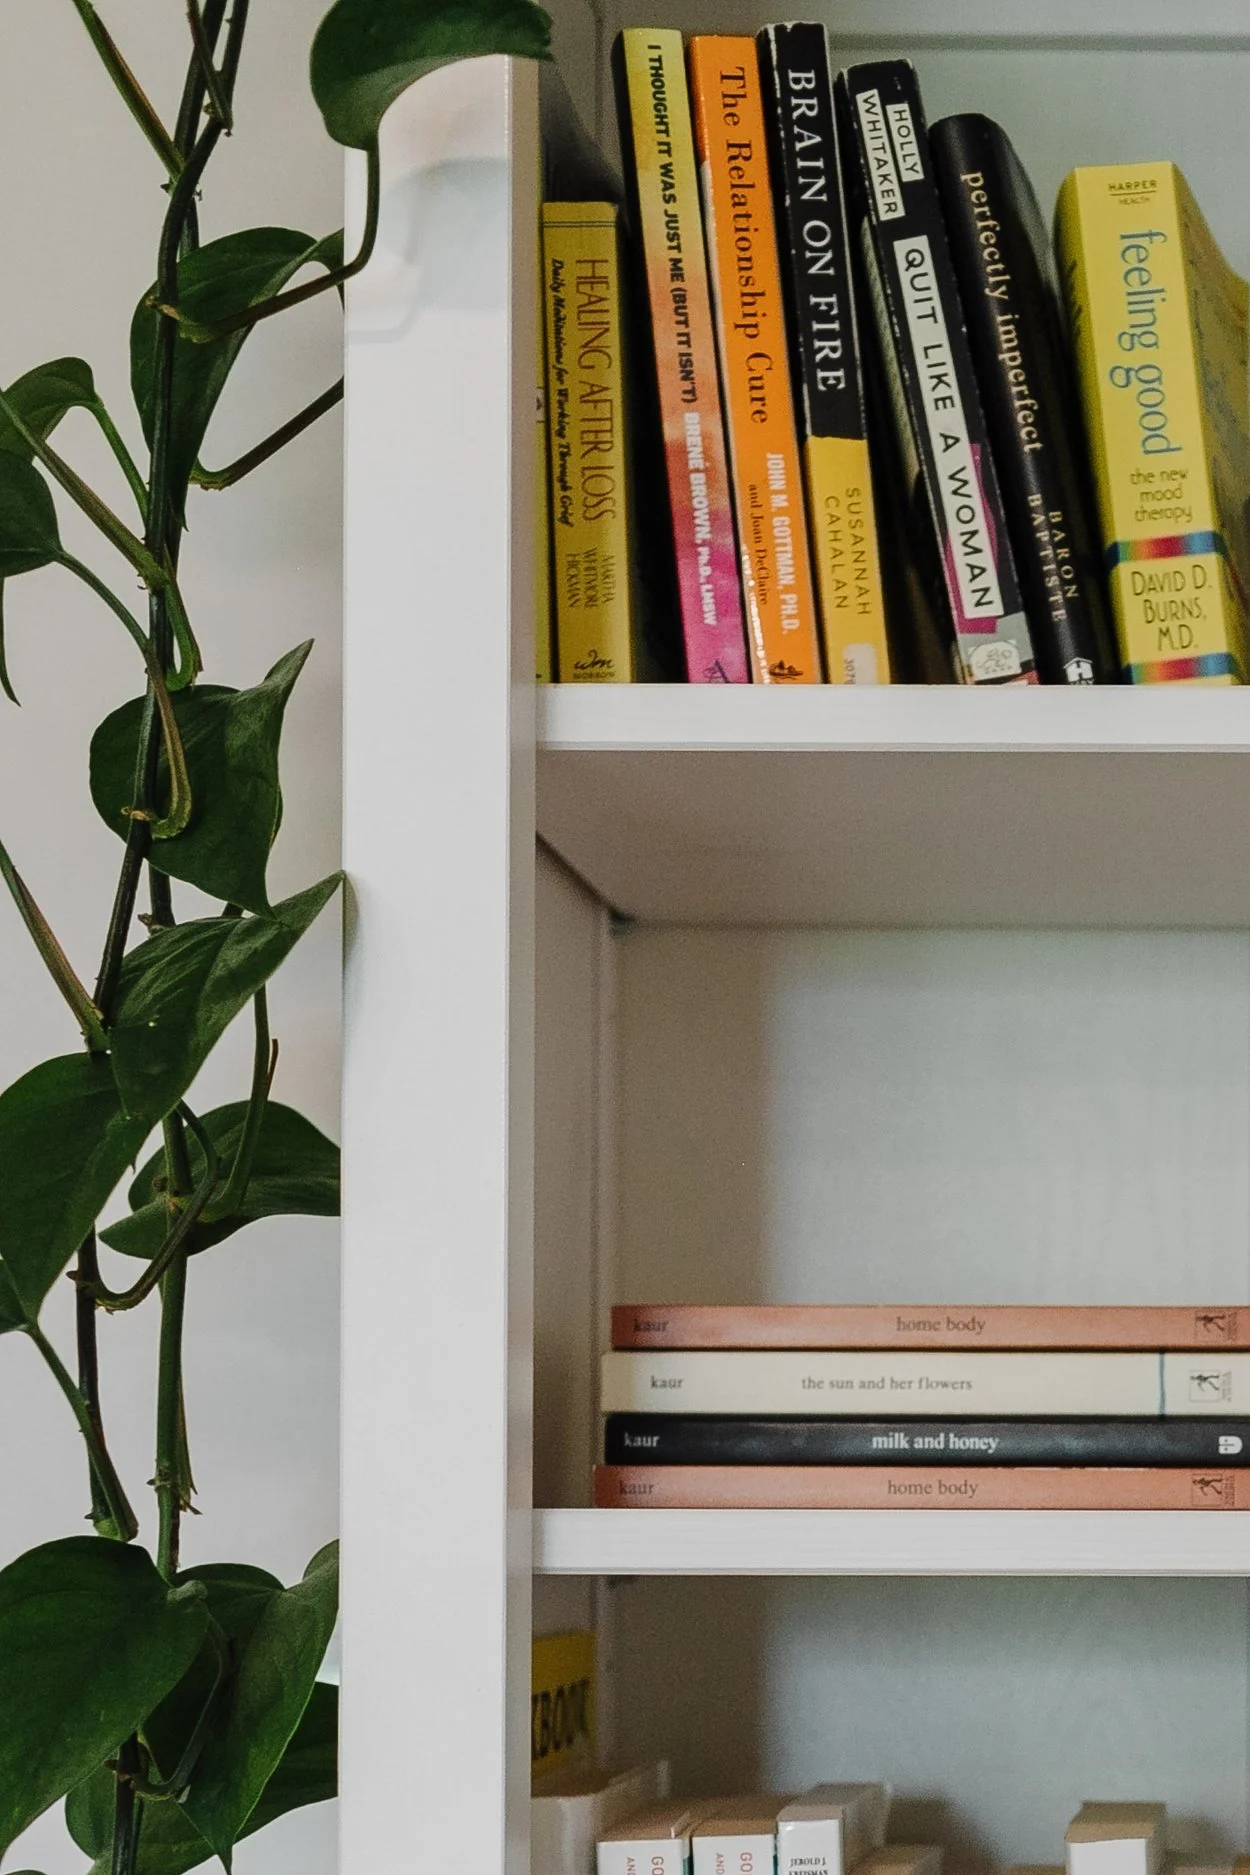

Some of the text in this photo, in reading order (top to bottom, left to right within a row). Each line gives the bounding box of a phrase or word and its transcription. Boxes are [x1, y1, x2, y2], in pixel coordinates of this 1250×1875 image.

[648, 55, 670, 138] THOUGHT
[657, 141, 672, 158] IT
[862, 94, 898, 214] WHITAKER
[892, 109, 920, 175] HOLLY
[658, 163, 676, 204] WAS
[664, 209, 682, 257] JUST
[720, 66, 774, 424] The Relationship Cure
[788, 69, 847, 391] BRAIN ON FIRE
[668, 259, 686, 283] ME
[904, 248, 938, 324] QUIT
[670, 287, 690, 326] (BUT
[960, 171, 1044, 452] perfectly imperfect
[676, 330, 692, 349] IT
[1109, 230, 1182, 456] feeling good
[575, 259, 615, 521] HEALING AFTER LOSS
[677, 353, 698, 404] ISN'T)
[922, 344, 956, 411] LIKE
[939, 432, 962, 454] A
[1130, 468, 1188, 486] the new
[1140, 488, 1183, 502] mood
[948, 465, 994, 610] WOMAN
[1135, 504, 1193, 524] therapy
[823, 496, 850, 609] CAHALAN
[845, 487, 873, 615] SUSANNAH
[1028, 493, 1066, 622] BAPTISTE
[1049, 511, 1078, 598] BARON
[1132, 565, 1212, 596] DAVID D.
[1144, 598, 1207, 624] BURNS,
[1157, 624, 1198, 652] M.D.
[896, 1312, 986, 1335] home body
[802, 1376, 973, 1390] the sun and her flowers
[872, 1432, 999, 1454] milk and honey
